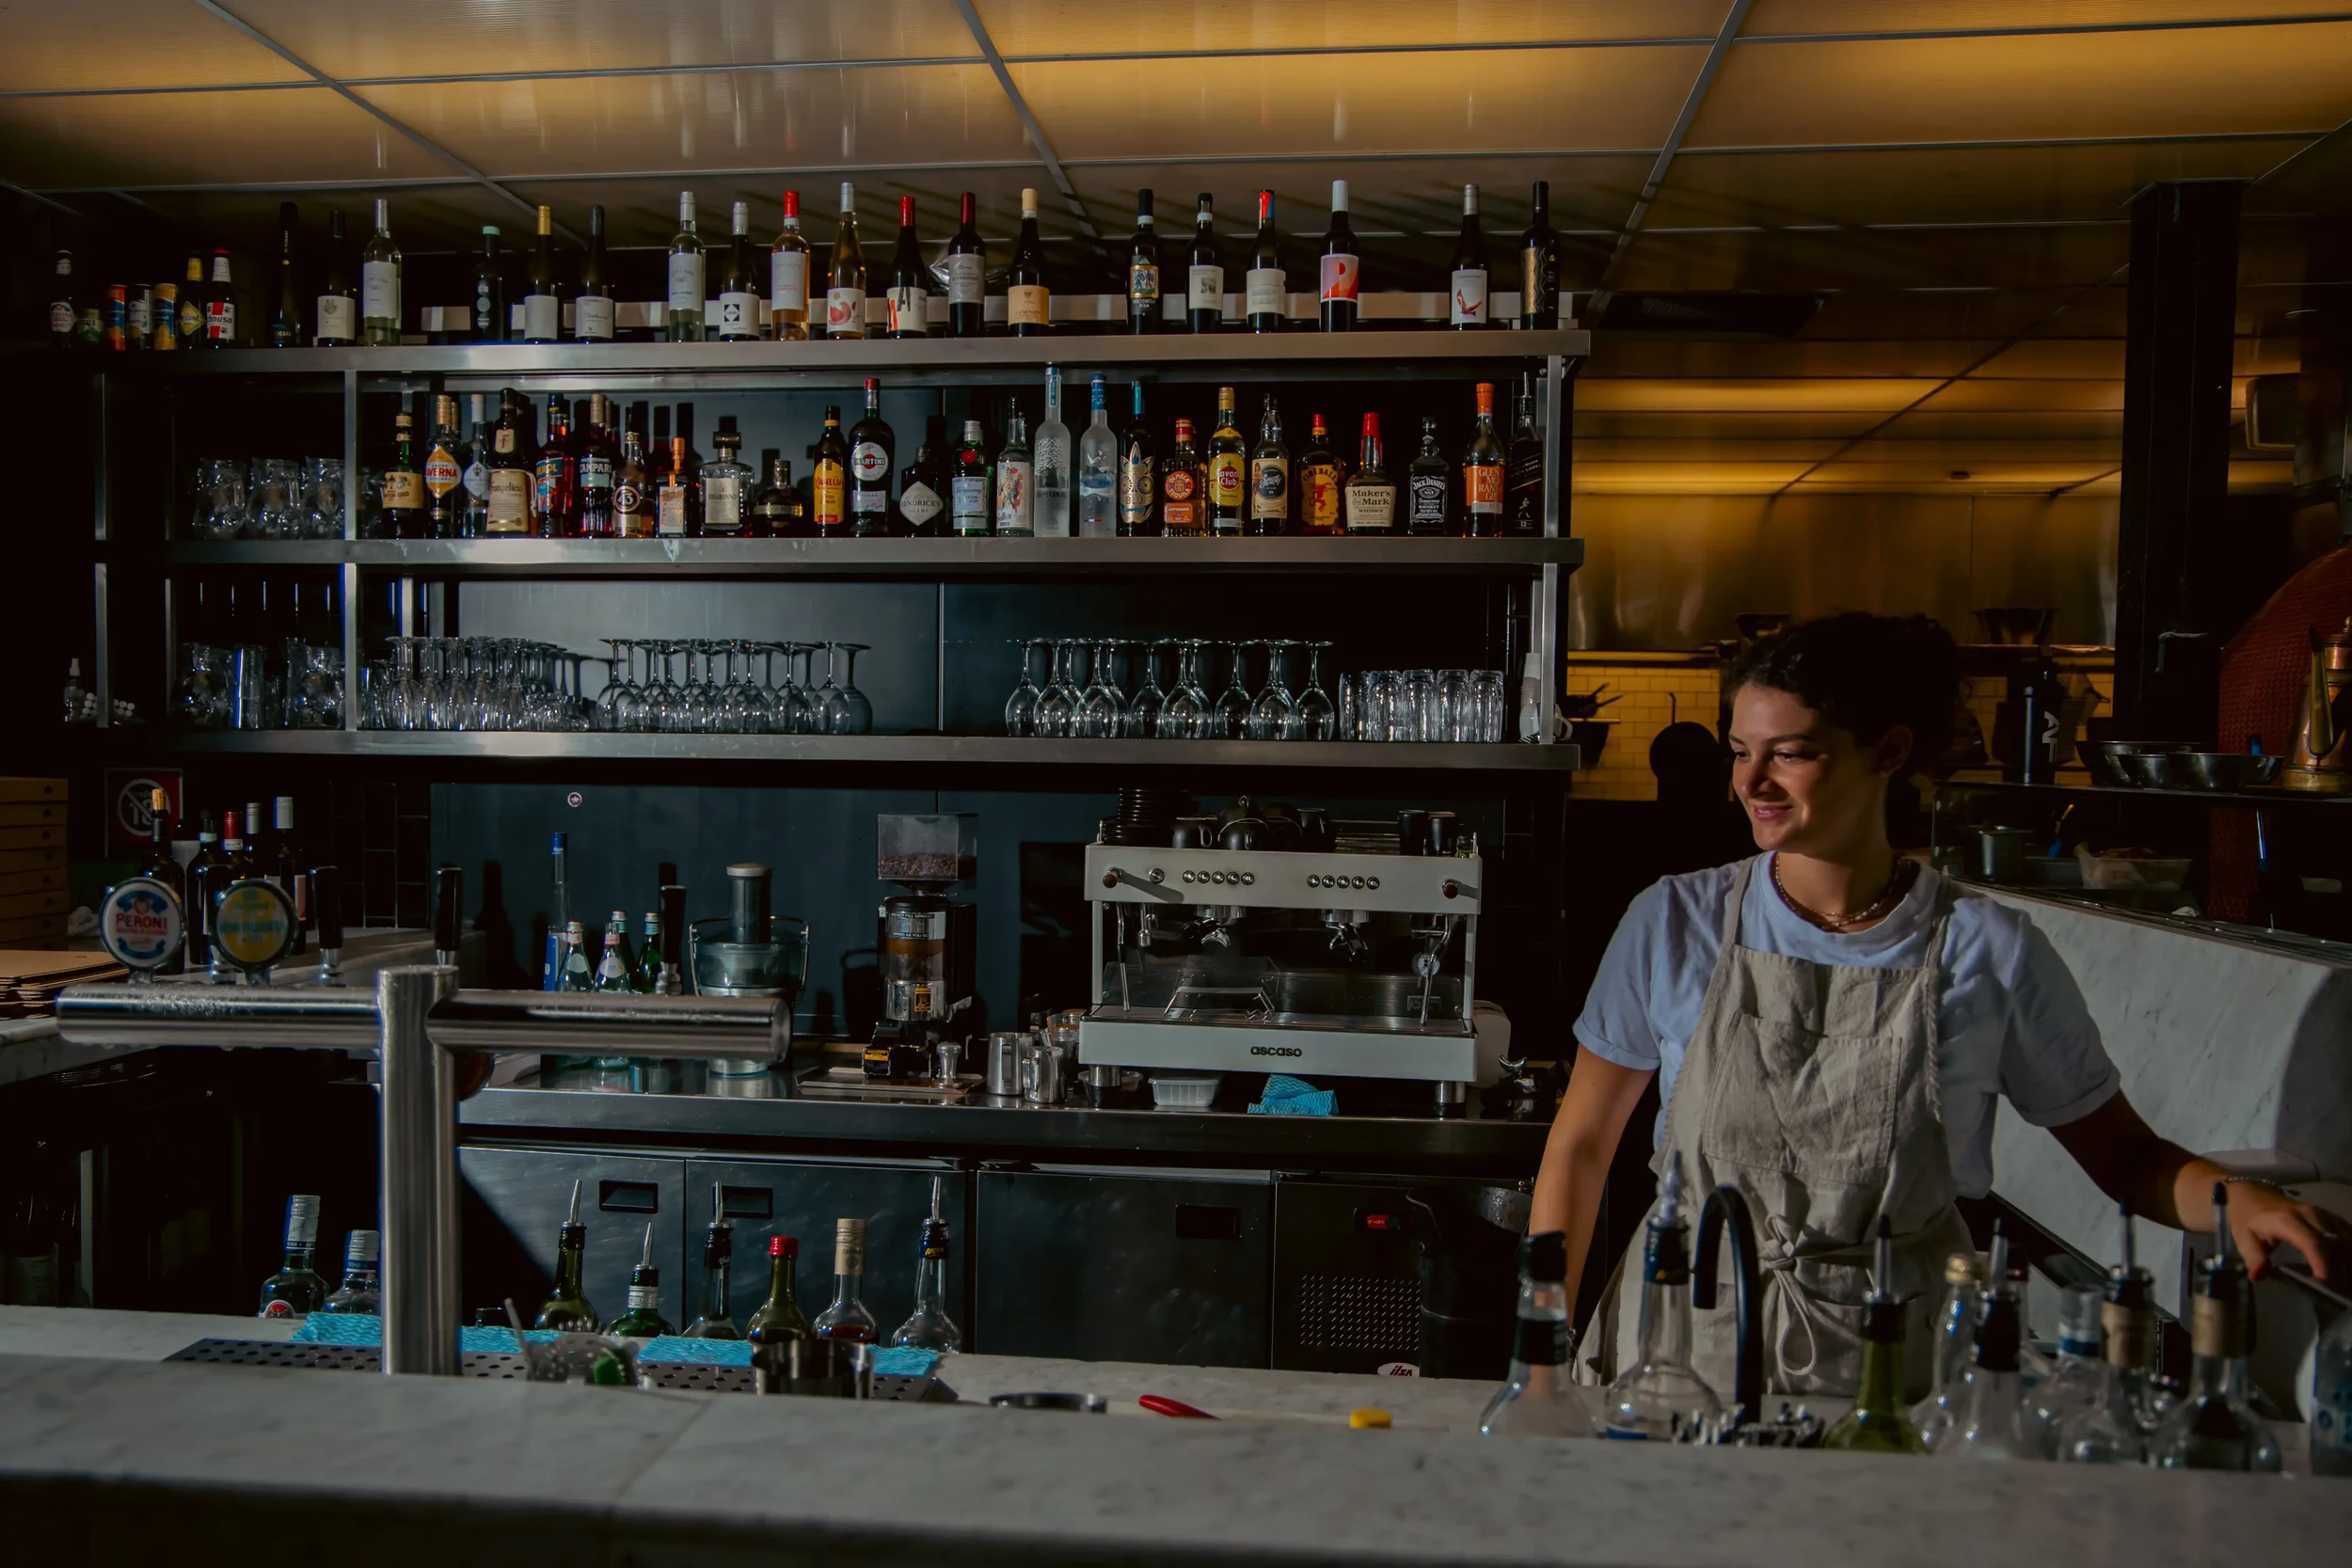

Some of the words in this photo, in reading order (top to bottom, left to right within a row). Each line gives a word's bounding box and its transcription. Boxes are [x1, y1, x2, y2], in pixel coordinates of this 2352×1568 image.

[580, 464, 612, 473] CAMPARI
[1478, 468, 1500, 477] GLEN
[1168, 473, 1190, 483] OLMECA
[1302, 468, 1338, 482] FIREBALL
[1168, 488, 1191, 499] TEQUILA
[116, 912, 167, 929] PERONI
[1250, 1046, 1303, 1057] ascaso
